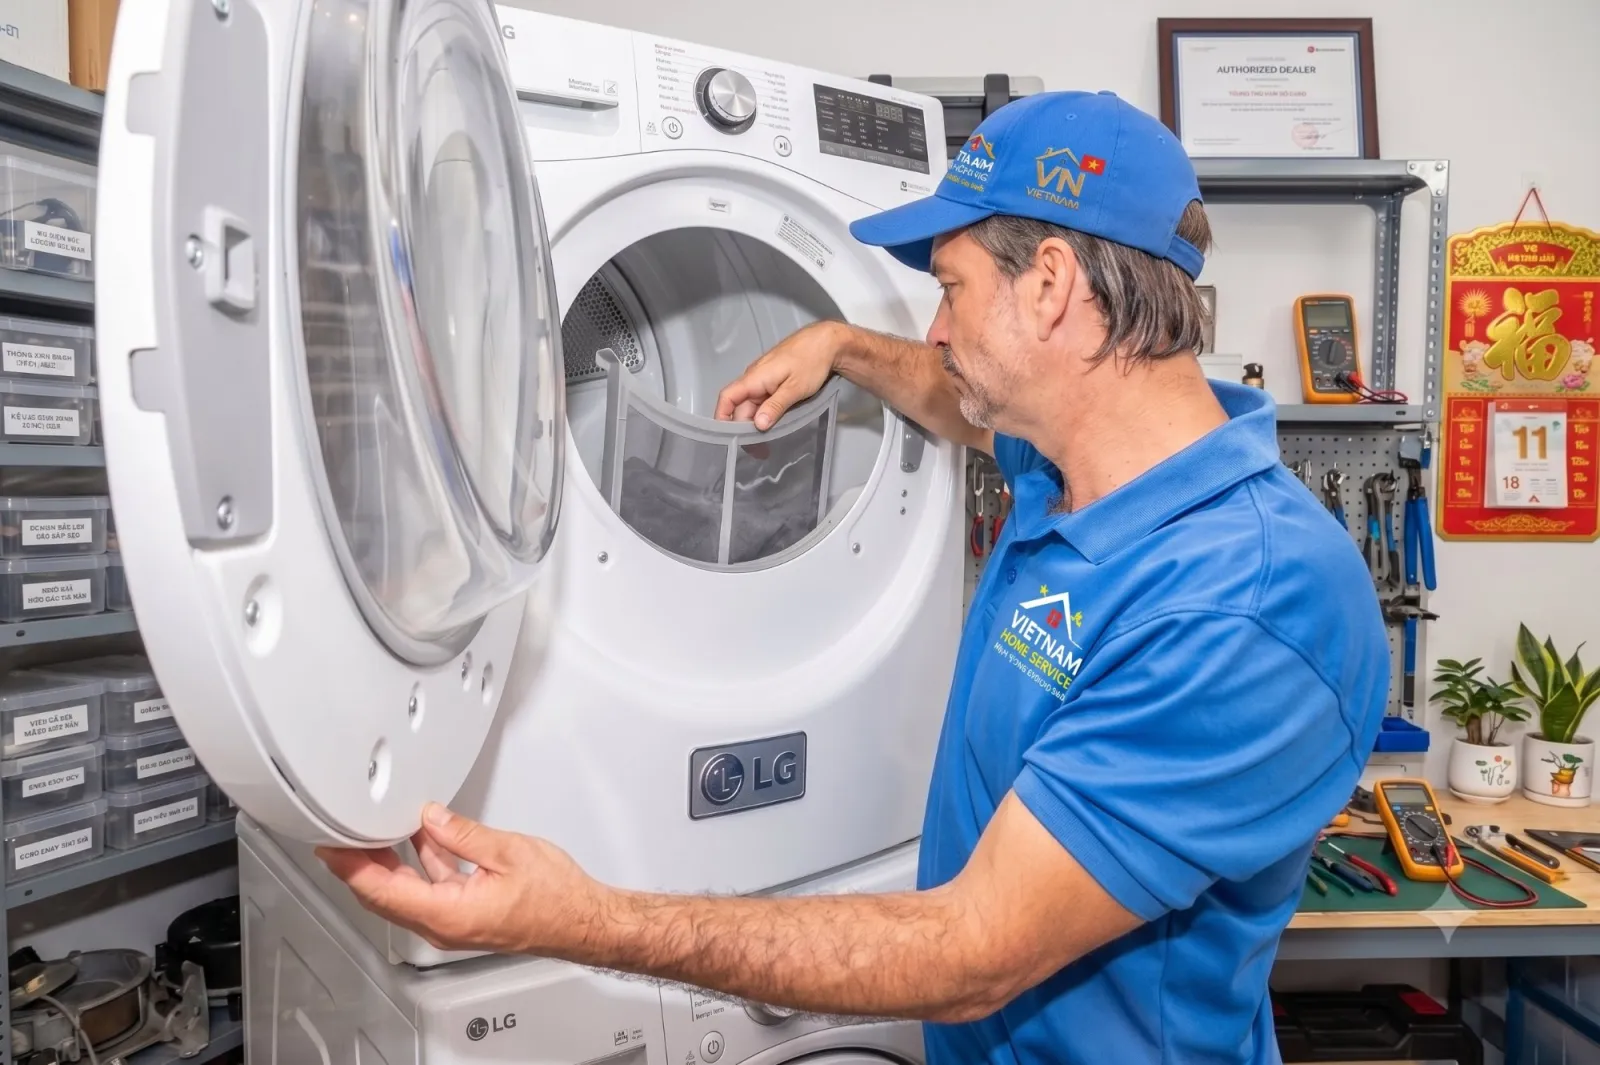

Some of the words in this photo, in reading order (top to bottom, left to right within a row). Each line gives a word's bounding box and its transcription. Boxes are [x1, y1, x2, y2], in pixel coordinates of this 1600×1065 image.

[501, 24, 516, 40] G
[1216, 65, 1278, 75] AUTHORIZED
[1279, 65, 1317, 75] DEALER
[1036, 160, 1086, 198] VN
[1025, 184, 1080, 211] VIETNAM
[1483, 287, 1573, 381] 福
[1512, 425, 1548, 460] 11
[1502, 475, 1520, 489] 18
[1000, 627, 1031, 659] HOME
[1028, 651, 1073, 690] SERVICE
[1010, 608, 1084, 677] VIETNAM
[752, 750, 797, 791] LG
[492, 1012, 517, 1033] LG
